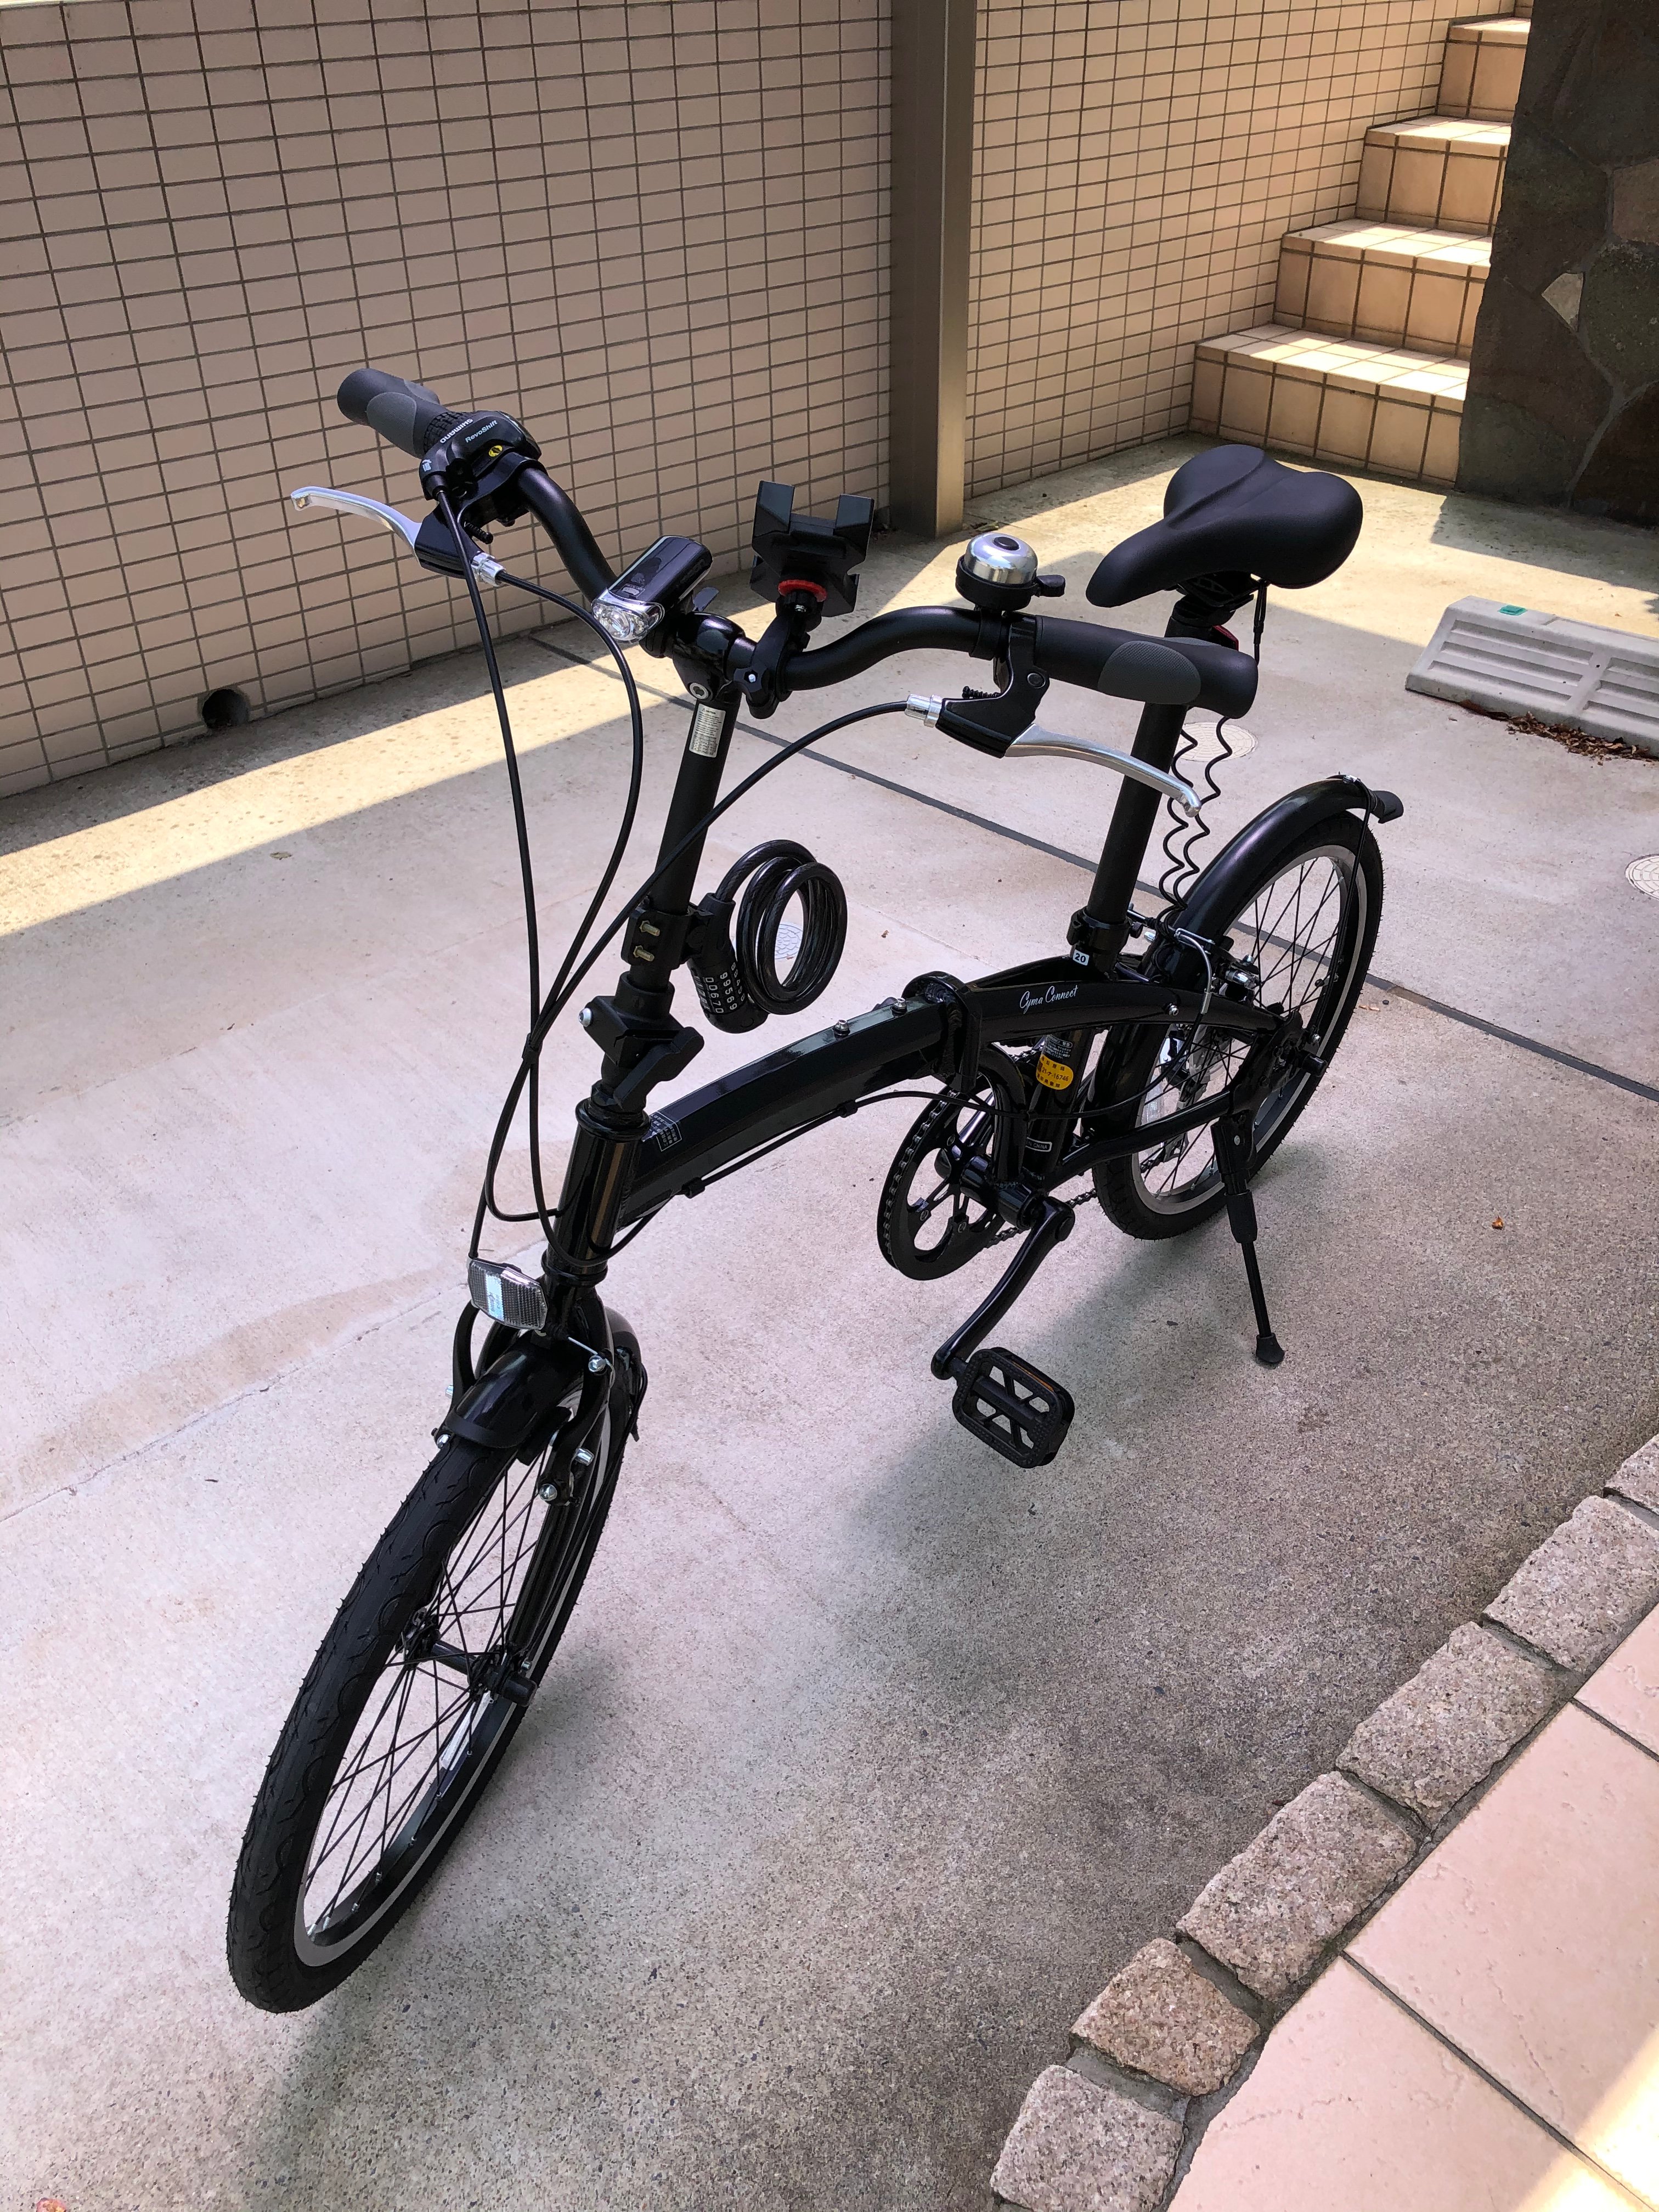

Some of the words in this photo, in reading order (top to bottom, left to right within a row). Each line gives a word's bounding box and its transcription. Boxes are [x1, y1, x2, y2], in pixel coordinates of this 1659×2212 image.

[439, 418, 473, 443] SHIMANO
[465, 420, 498, 443] RevoShift
[1075, 952, 1086, 963] 20
[1020, 991, 1043, 1014] Cyma
[1045, 985, 1078, 1003] Connect
